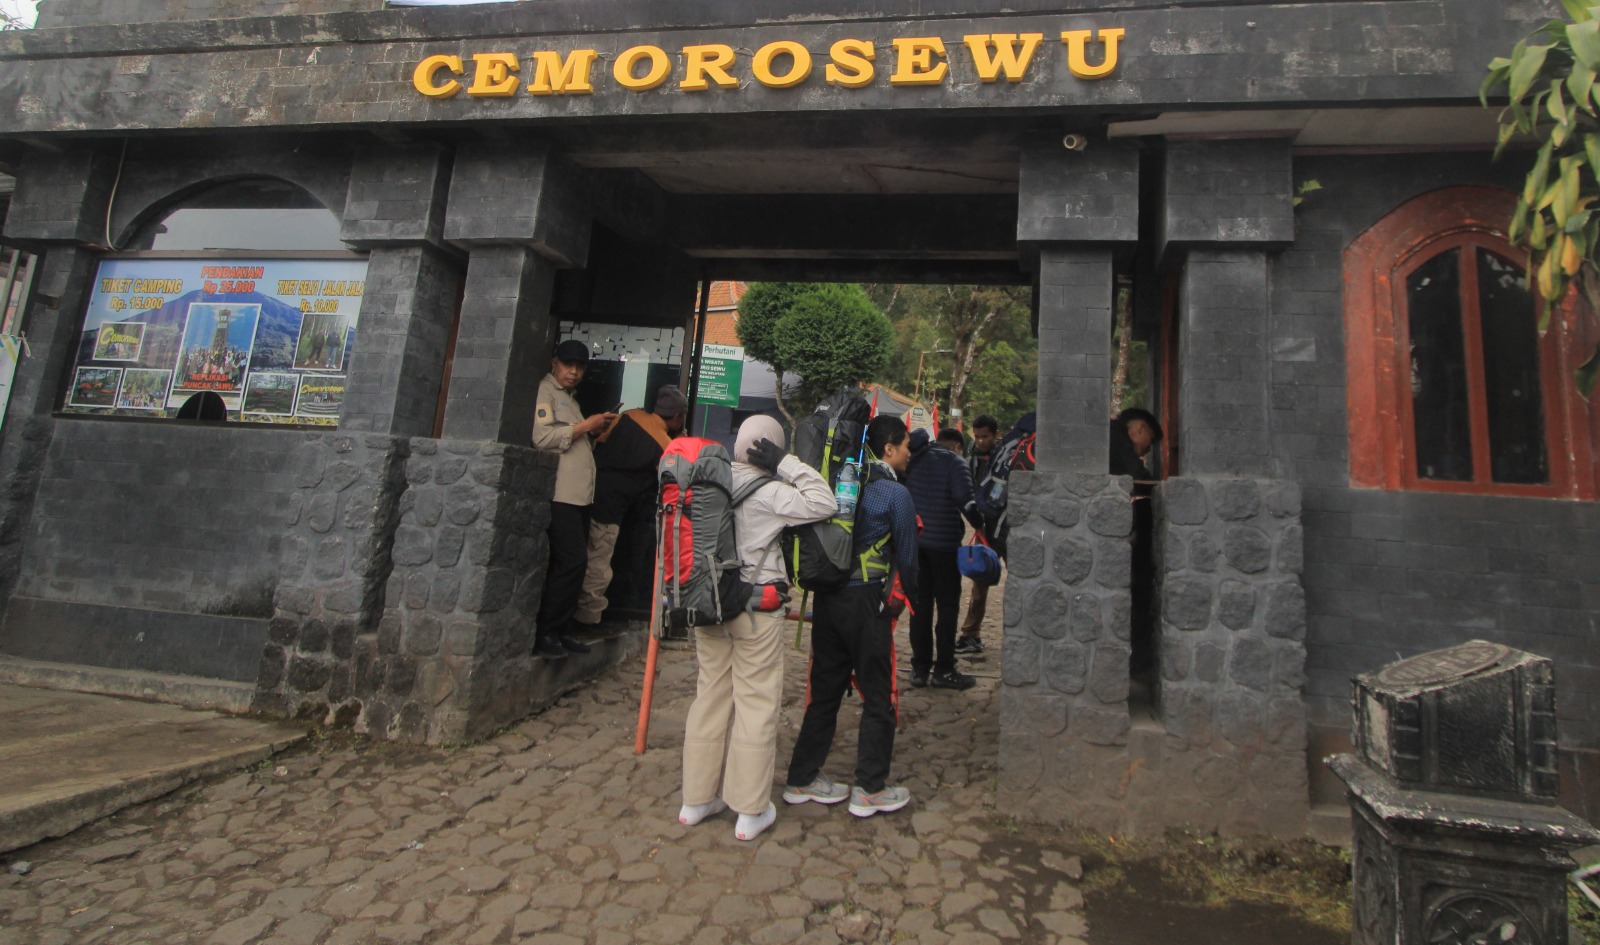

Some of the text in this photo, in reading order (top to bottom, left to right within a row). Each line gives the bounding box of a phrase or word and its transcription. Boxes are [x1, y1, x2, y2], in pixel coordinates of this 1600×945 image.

[412, 27, 1126, 99] CEMOROSEWU
[201, 265, 264, 279] PENDAKIAN
[101, 278, 183, 294] TIKET CAMPING
[203, 280, 255, 296] Rp 25.000
[277, 279, 299, 296] TIKET
[322, 280, 347, 296] JALAN
[346, 280, 365, 297] JALA
[110, 296, 164, 312] Rp. 15.000
[314, 299, 339, 313] 10.000
[704, 345, 736, 356] Perhutani
[183, 381, 211, 390] PUNCAK
